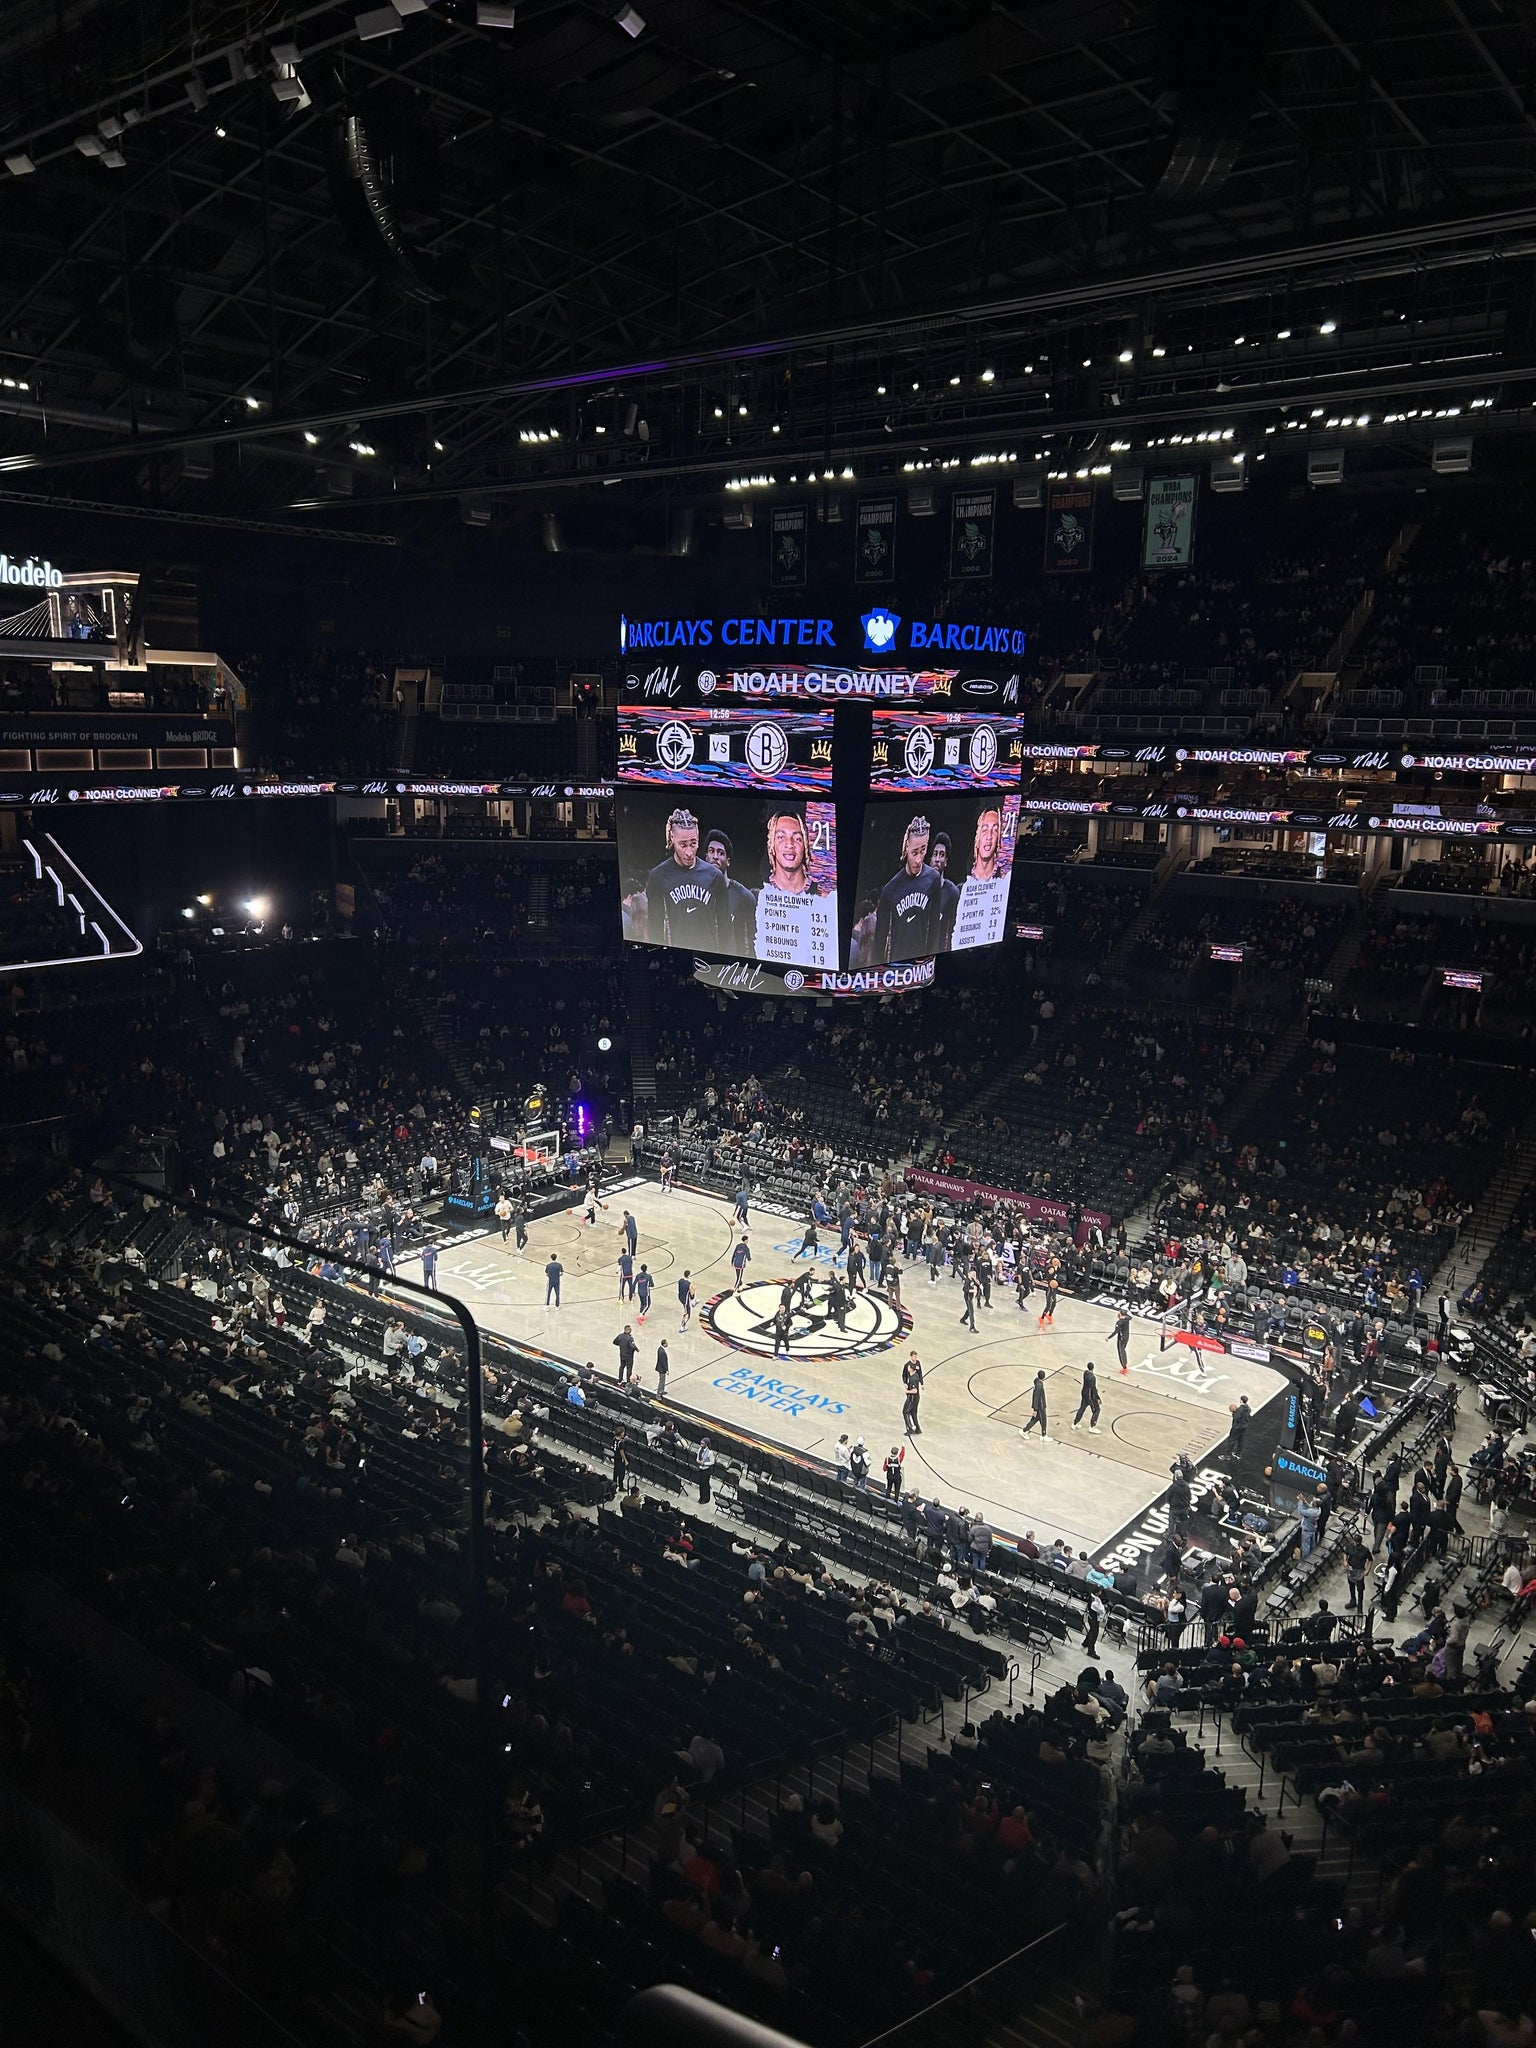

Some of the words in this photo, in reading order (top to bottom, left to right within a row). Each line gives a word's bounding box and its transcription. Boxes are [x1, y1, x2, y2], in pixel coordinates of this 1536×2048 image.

[1163, 482, 1181, 491] WNBA
[1151, 491, 1192, 506] CHAMPIONS
[956, 502, 992, 518] CHAMPIONS
[859, 512, 893, 526] CHAMPIONS
[1156, 555, 1178, 563] 2024
[629, 619, 713, 648] BARCLAYS
[721, 619, 836, 647] CENTER
[910, 621, 1010, 653] BARCLAYS
[733, 672, 798, 694] NOAH
[803, 673, 920, 695] CLOWNEY
[709, 709, 730, 719] 12:56
[3, 732, 46, 741] FIGHTING
[48, 732, 76, 741] SPIRIT
[80, 732, 91, 741] OF
[93, 732, 138, 741] BROOKLYN
[166, 731, 192, 742] Modelo
[193, 731, 218, 742] BRIDGE
[712, 741, 727, 753] VS
[947, 745, 957, 756] VS
[1031, 746, 1080, 757] CLOWNEY
[1195, 750, 1228, 761] NOAH
[1229, 751, 1287, 763] CLOWNEY
[1425, 756, 1464, 768] NOAH
[1465, 757, 1534, 770] CLOWNEY
[86, 790, 115, 799] NOAH
[116, 788, 162, 798] CLOWNEY
[258, 785, 281, 795] NOAH
[282, 784, 321, 794] CLOWNEY
[411, 783, 438, 793] NOAH
[439, 784, 483, 794] CLOWNEY
[579, 787, 605, 796] NOAH
[1026, 801, 1050, 810] NOAH
[1051, 802, 1094, 812] CLOWNEY
[1194, 808, 1227, 819] NOAH
[1229, 810, 1272, 821] CLOWNEY
[1003, 812, 1016, 838] 21
[1388, 819, 1420, 829] NOAH
[1422, 820, 1479, 832] CLOWNEY
[812, 820, 830, 851] 21
[669, 884, 711, 906] BROOKLYN
[765, 894, 782, 903] NOAH
[783, 896, 813, 907] CLOWNEY
[896, 892, 928, 917] BROOKLYN
[764, 908, 787, 918] POINTS
[811, 913, 828, 923] 13.1
[765, 922, 789, 933] 3-POINT
[791, 924, 799, 934] FG
[811, 927, 829, 937] 32%
[766, 936, 798, 947] REBOUNDS
[811, 941, 824, 951] 3.9
[766, 949, 791, 960] ASSISTS
[812, 955, 825, 965] 1.9
[821, 972, 879, 990] NOAH
[911, 1173, 934, 1186] QATAR
[935, 1180, 965, 1193] AIRWAYS
[980, 1190, 998, 1202] ATAR
[453, 1198, 474, 1209] BARCLAYS
[1040, 1206, 1066, 1218] QATAR
[711, 1376, 808, 1417] CENTER
[729, 1367, 851, 1416] BARCLAYS
[1289, 1395, 1297, 1422] BARCLAYS
[1099, 1531, 1163, 1574] Nets
